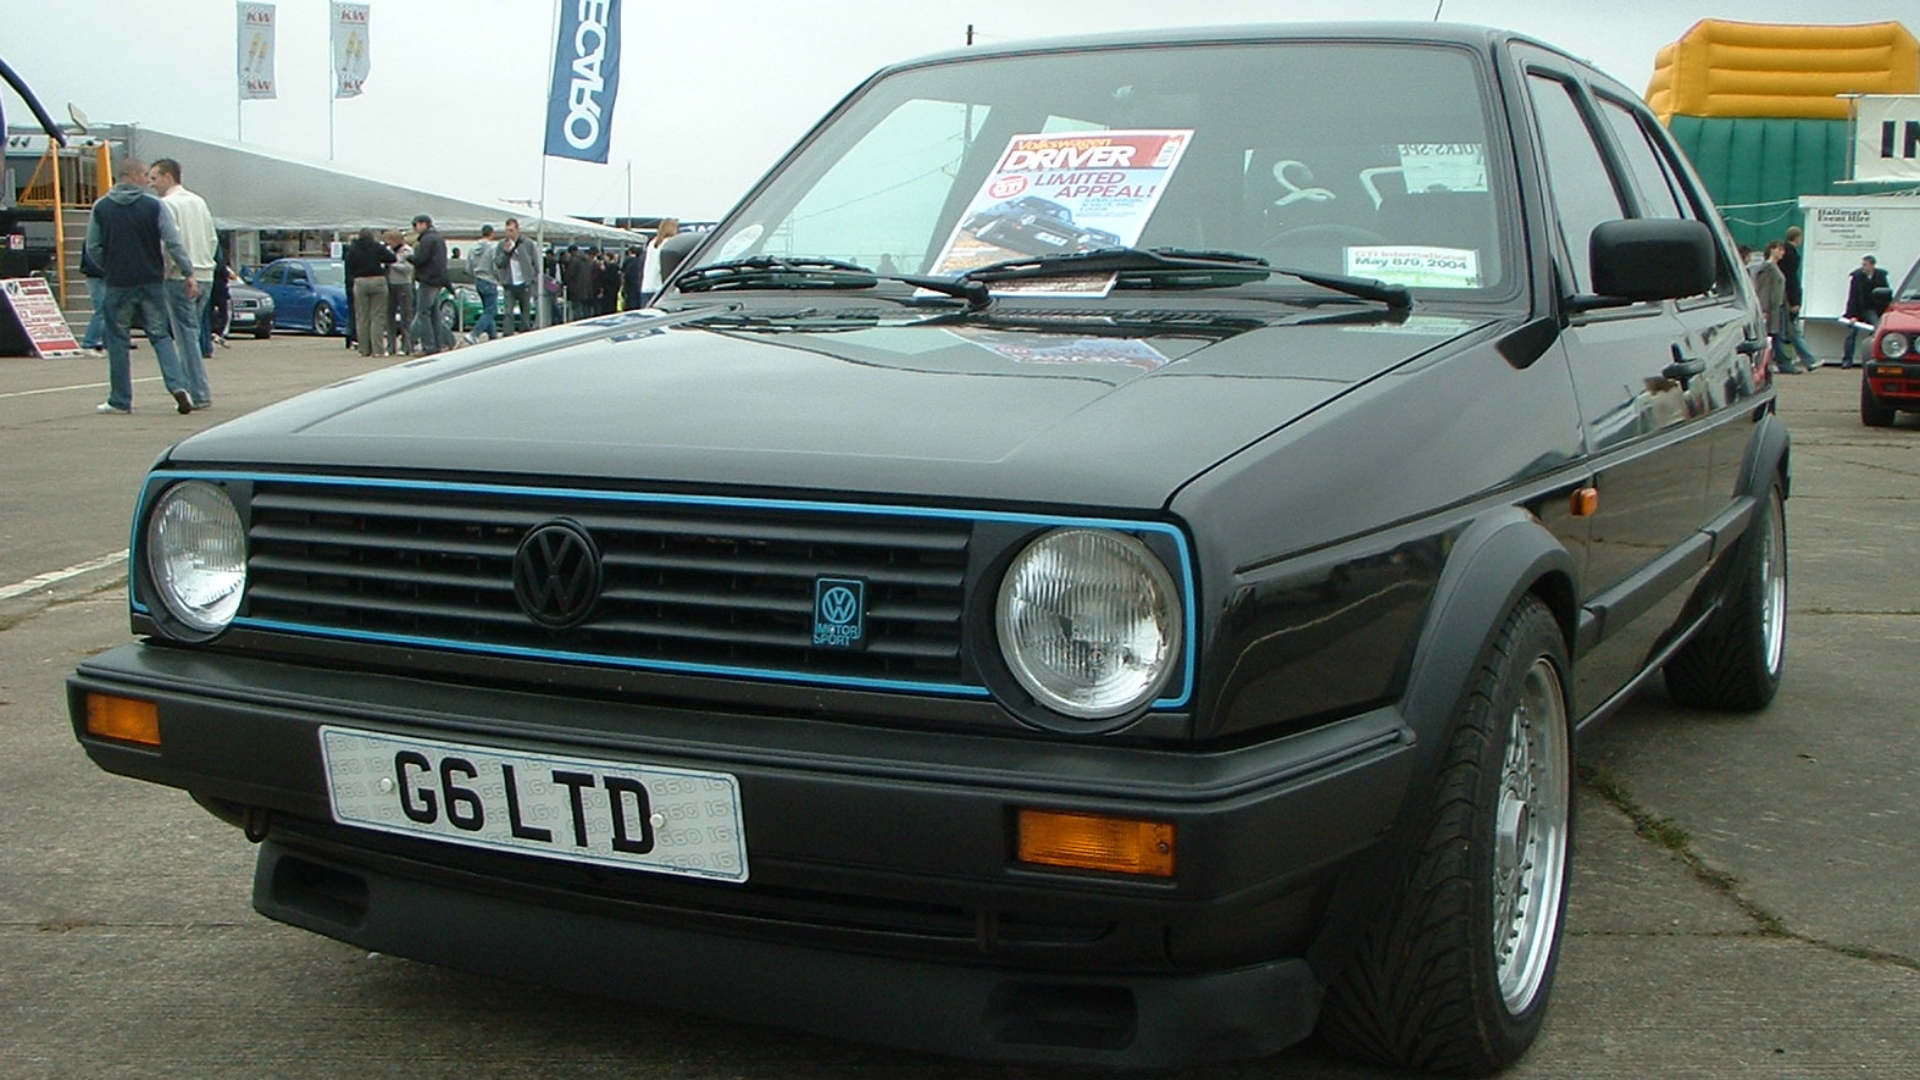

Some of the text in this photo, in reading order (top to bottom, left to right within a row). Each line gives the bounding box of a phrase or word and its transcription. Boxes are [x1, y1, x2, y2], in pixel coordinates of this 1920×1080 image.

[1017, 138, 1112, 151] Volkswagen
[1002, 146, 1136, 171] DRIVER
[1034, 171, 1126, 187] LIMITED
[1053, 184, 1157, 199] APPEAL!
[1355, 257, 1389, 268] May
[1427, 259, 1467, 269] 2004
[816, 623, 858, 635] MOTOR
[814, 634, 850, 645] SPORT
[395, 750, 484, 832] G6
[501, 763, 655, 855] LTD
